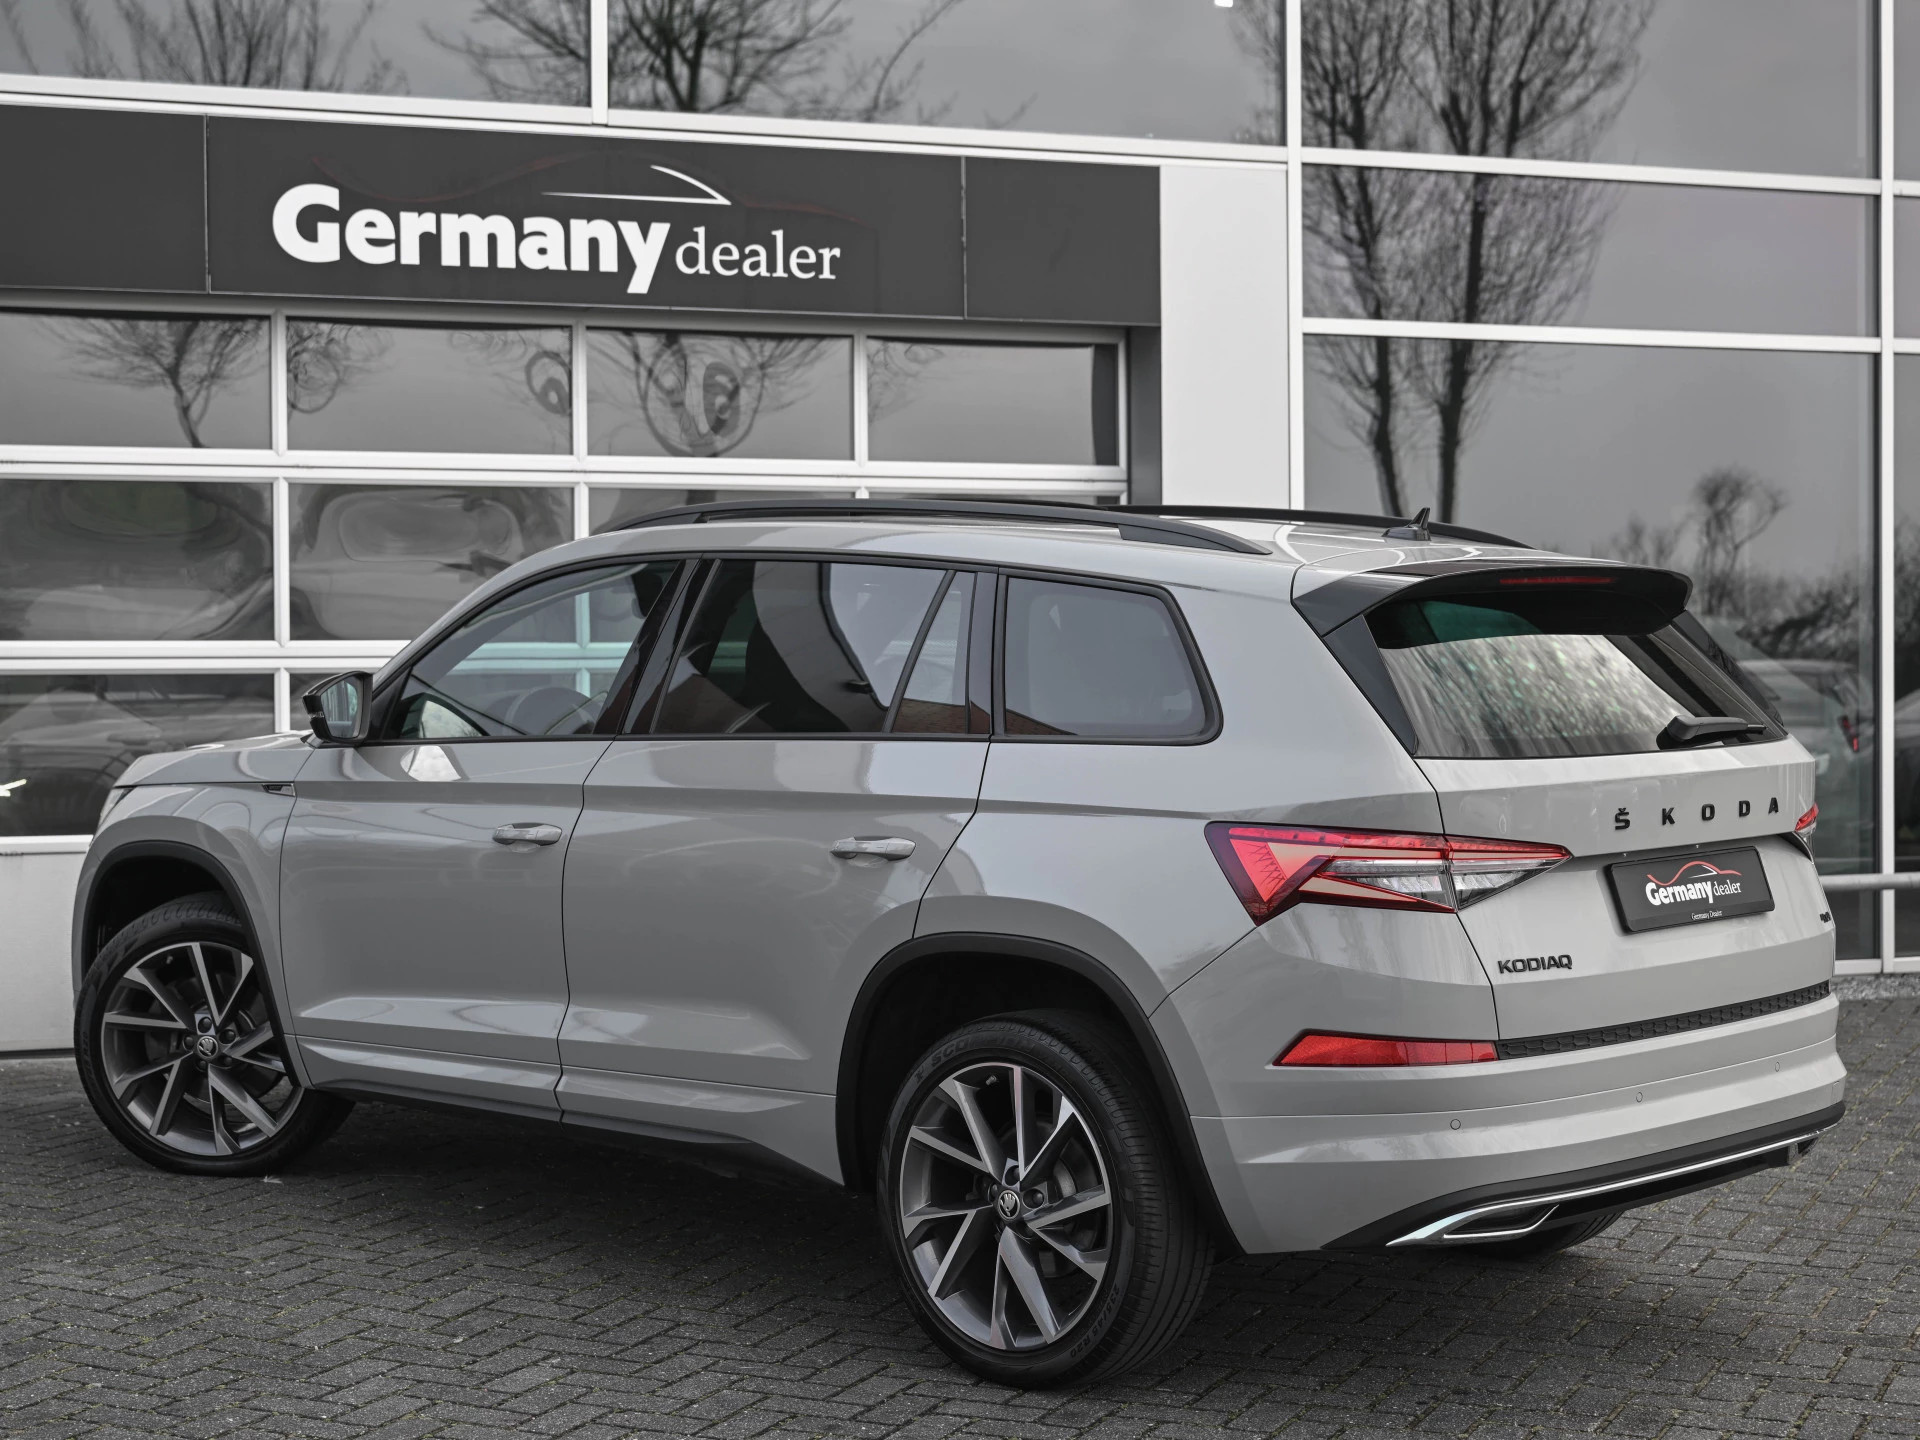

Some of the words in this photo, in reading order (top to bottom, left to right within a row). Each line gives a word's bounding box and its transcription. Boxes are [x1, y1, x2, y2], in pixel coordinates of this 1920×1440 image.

[272, 183, 671, 294] Germany
[675, 226, 840, 280] dealer
[1614, 797, 1779, 831] ŠKODA
[1645, 881, 1713, 906] Germany
[1713, 879, 1742, 896] dealer
[1497, 954, 1573, 974] KODIAQ
